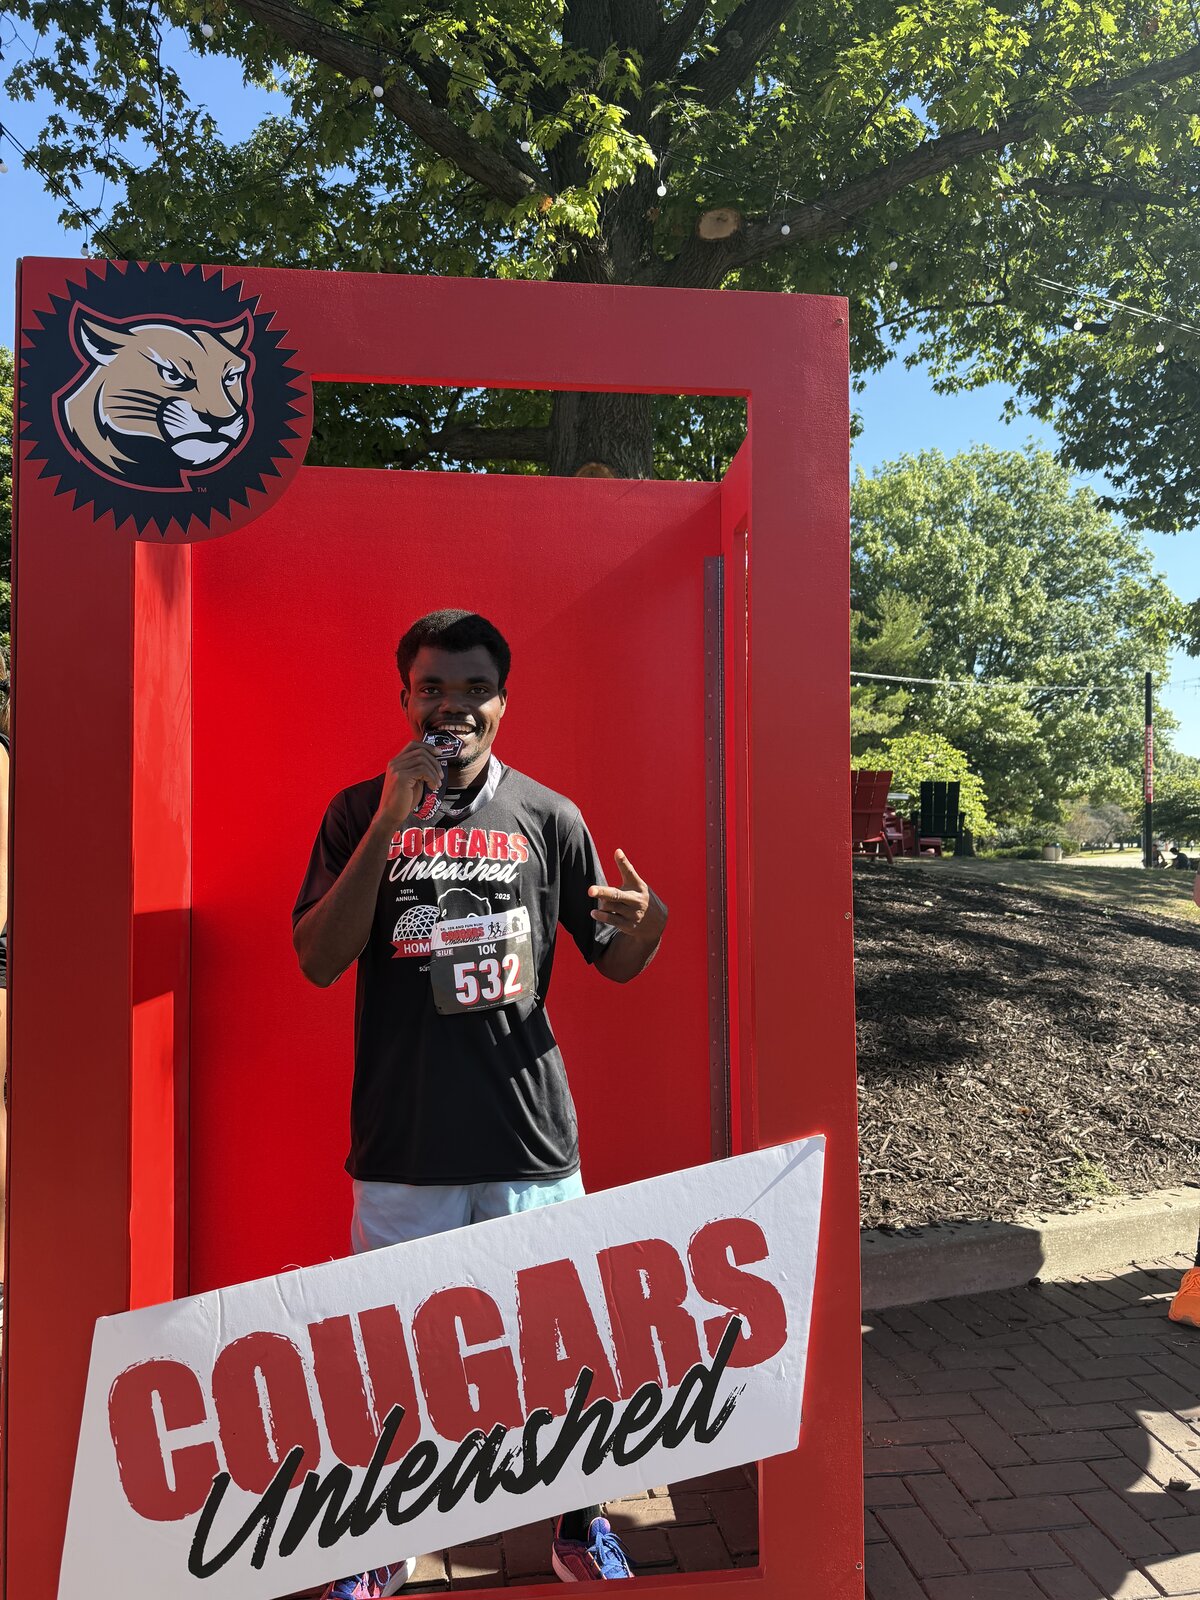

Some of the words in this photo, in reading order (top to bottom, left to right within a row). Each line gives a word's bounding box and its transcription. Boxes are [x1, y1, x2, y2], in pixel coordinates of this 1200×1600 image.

[388, 851, 519, 884] Unleashed
[494, 893, 511, 901] 2025
[403, 942, 430, 954] HOM
[437, 948, 453, 957] SIUE
[478, 943, 497, 956] 10K
[453, 953, 523, 1006] 532
[109, 1216, 788, 1522] COUGARS
[187, 1314, 746, 1579] Unleashed
